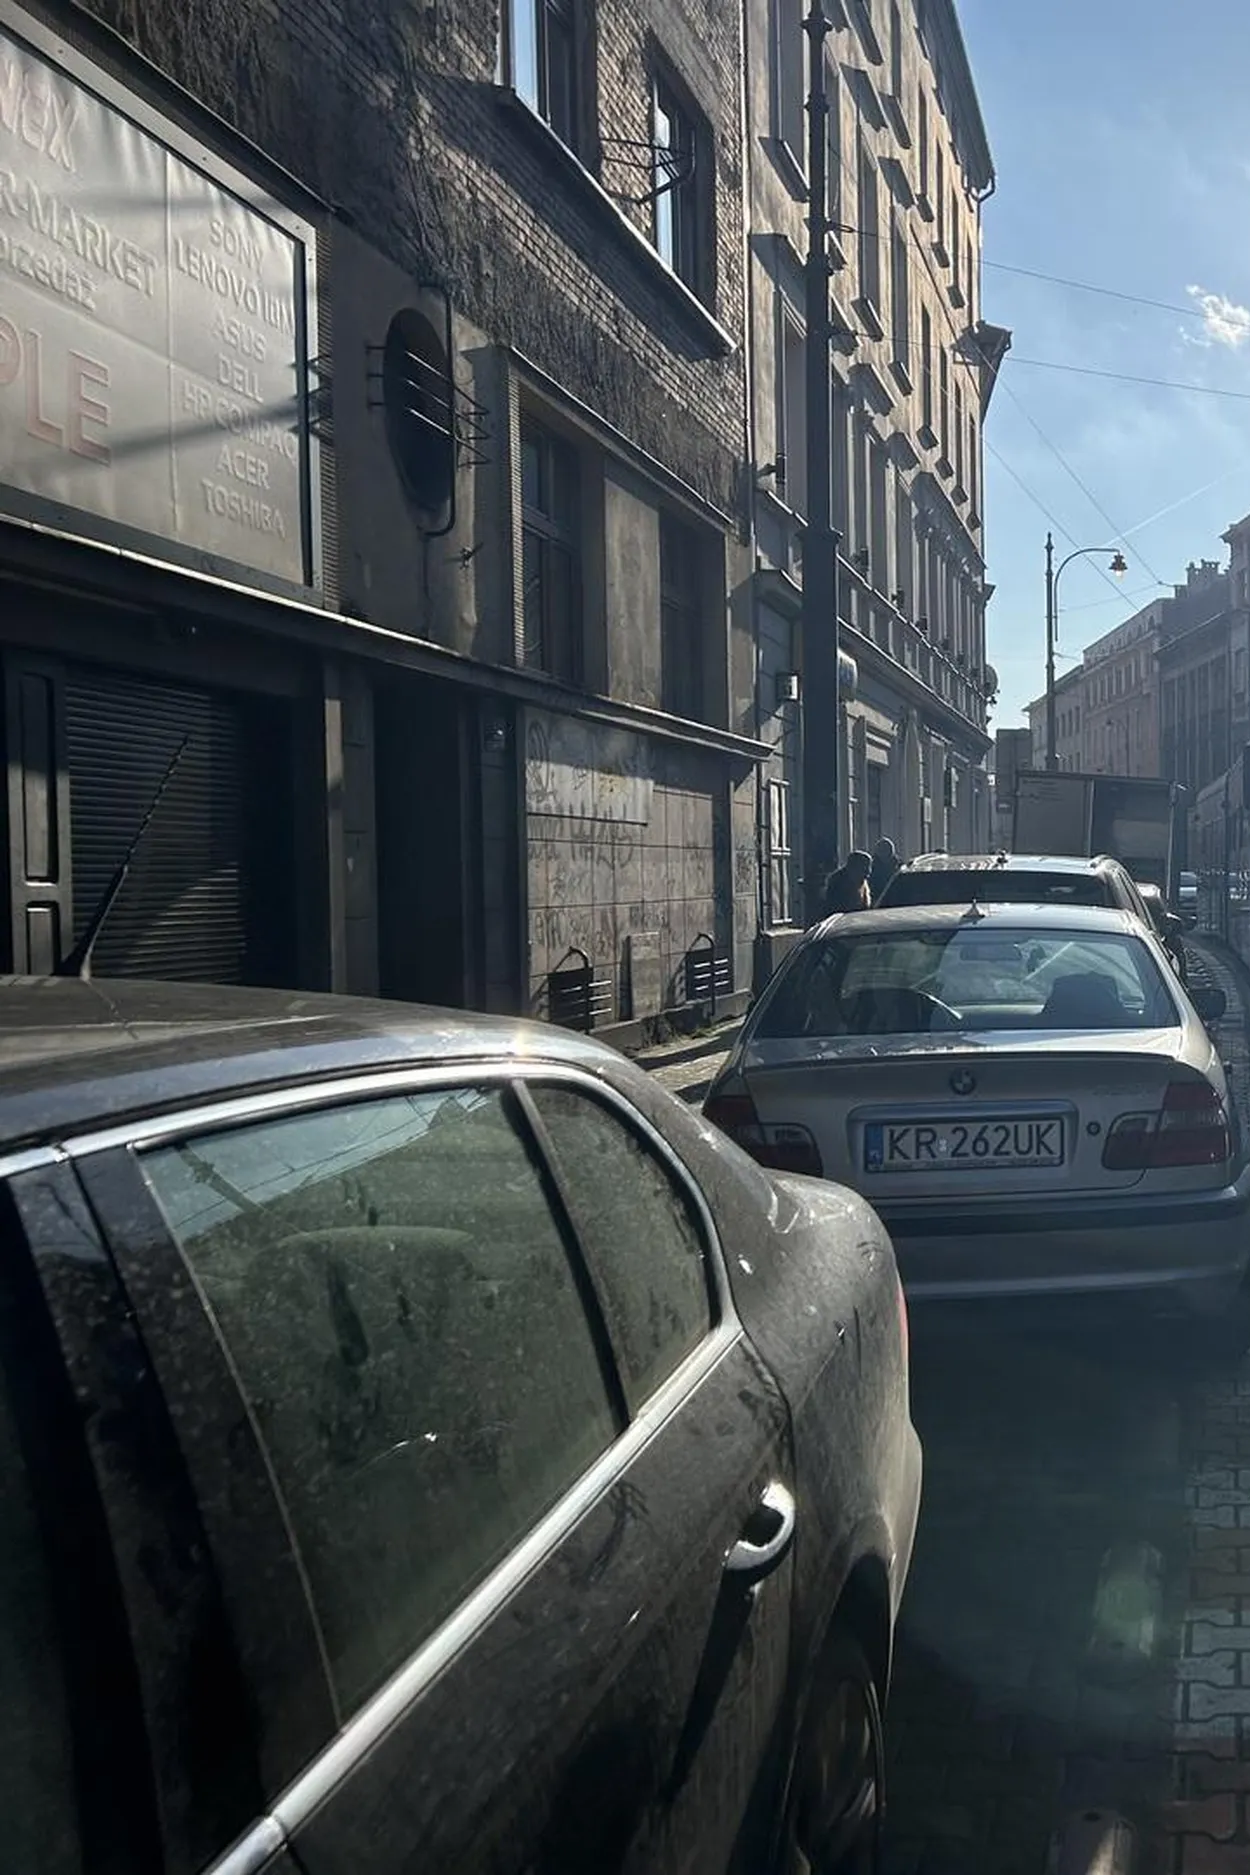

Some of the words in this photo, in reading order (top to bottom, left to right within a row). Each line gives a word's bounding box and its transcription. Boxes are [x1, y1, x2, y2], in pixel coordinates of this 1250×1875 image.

[210, 218, 263, 277] SONY
[175, 237, 261, 315] LENOVO
[213, 309, 267, 363] ASUS
[217, 353, 264, 404] DELL
[183, 379, 212, 420] HP
[215, 398, 299, 468] COMPAQ
[216, 444, 270, 490] ACER
[202, 477, 286, 540] TOSHIBA
[888, 1127, 938, 1161] KR
[951, 1122, 1057, 1158] 262UK
